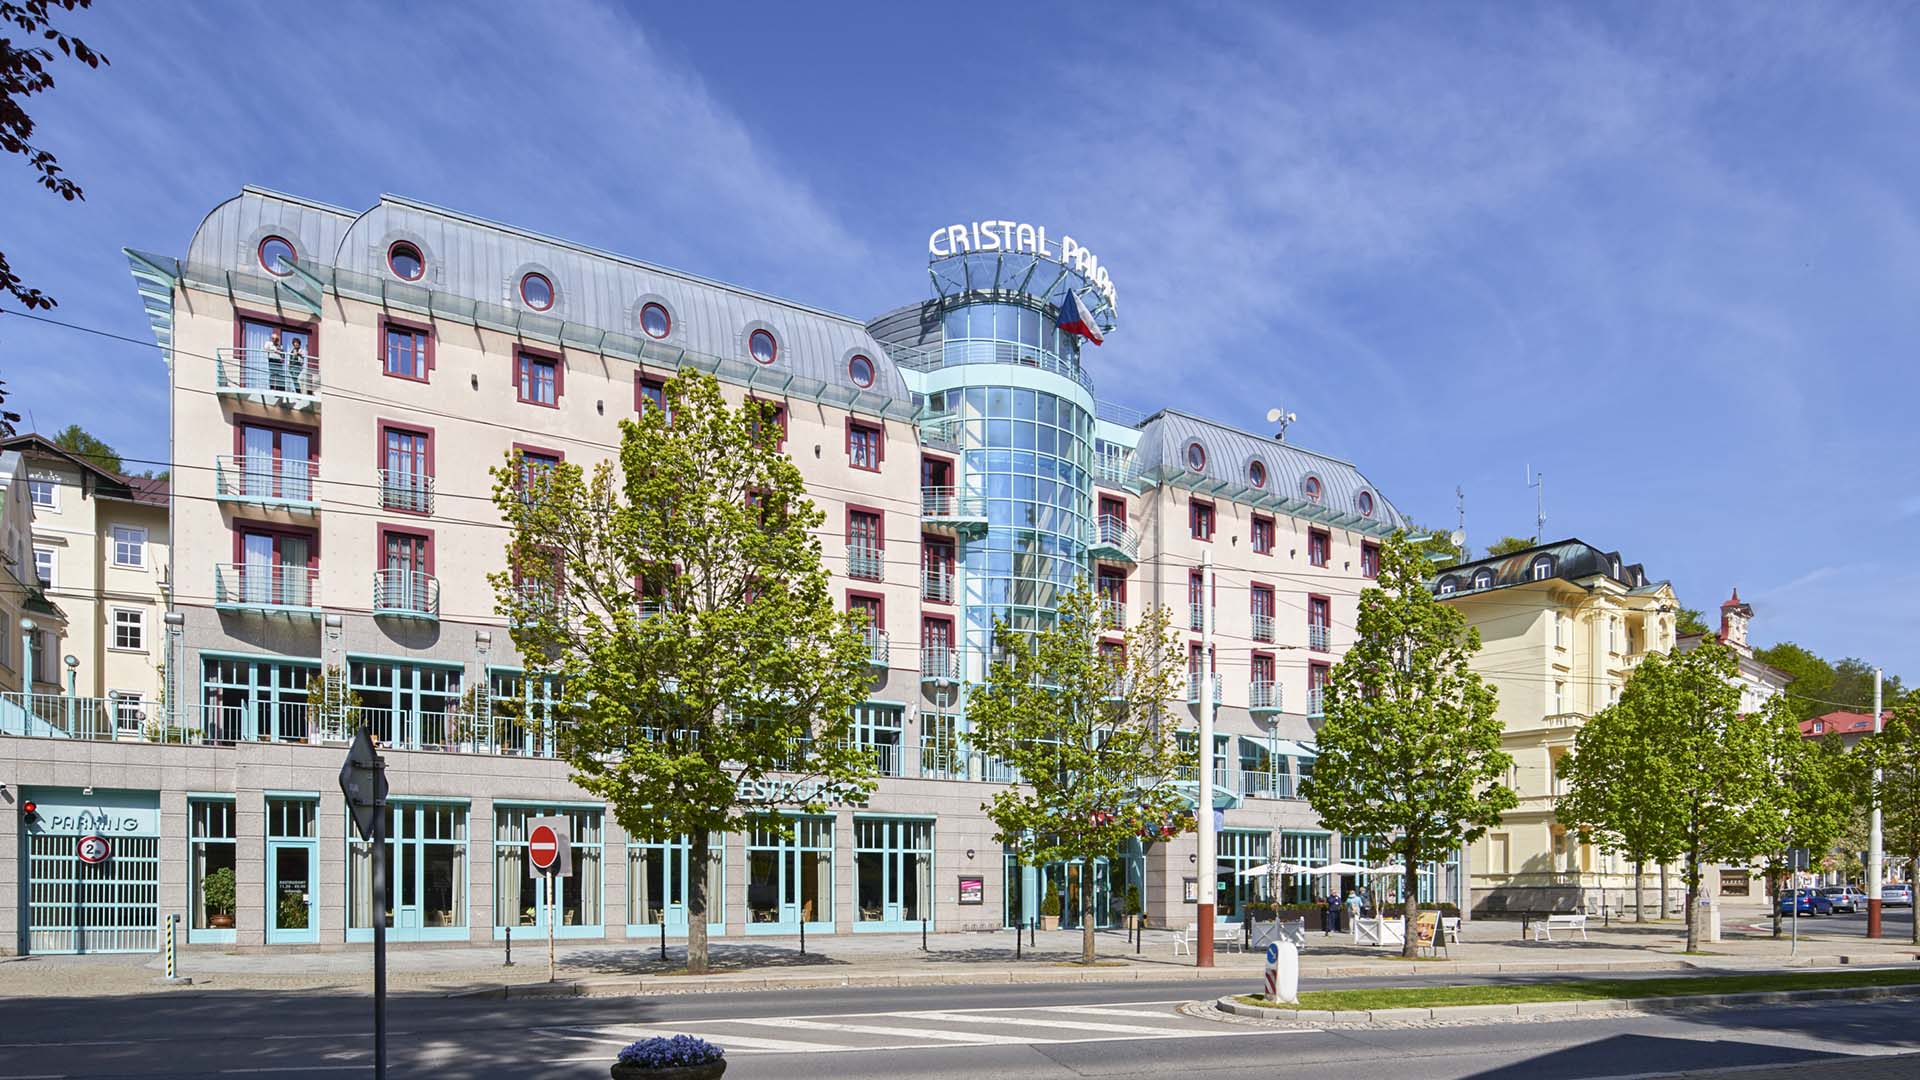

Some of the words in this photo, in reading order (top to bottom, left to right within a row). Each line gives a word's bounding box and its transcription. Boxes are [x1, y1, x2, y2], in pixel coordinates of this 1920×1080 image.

[929, 220, 1051, 257] CRISTAL
[1062, 235, 1118, 319] PALA
[736, 778, 870, 804] ESTAURACE
